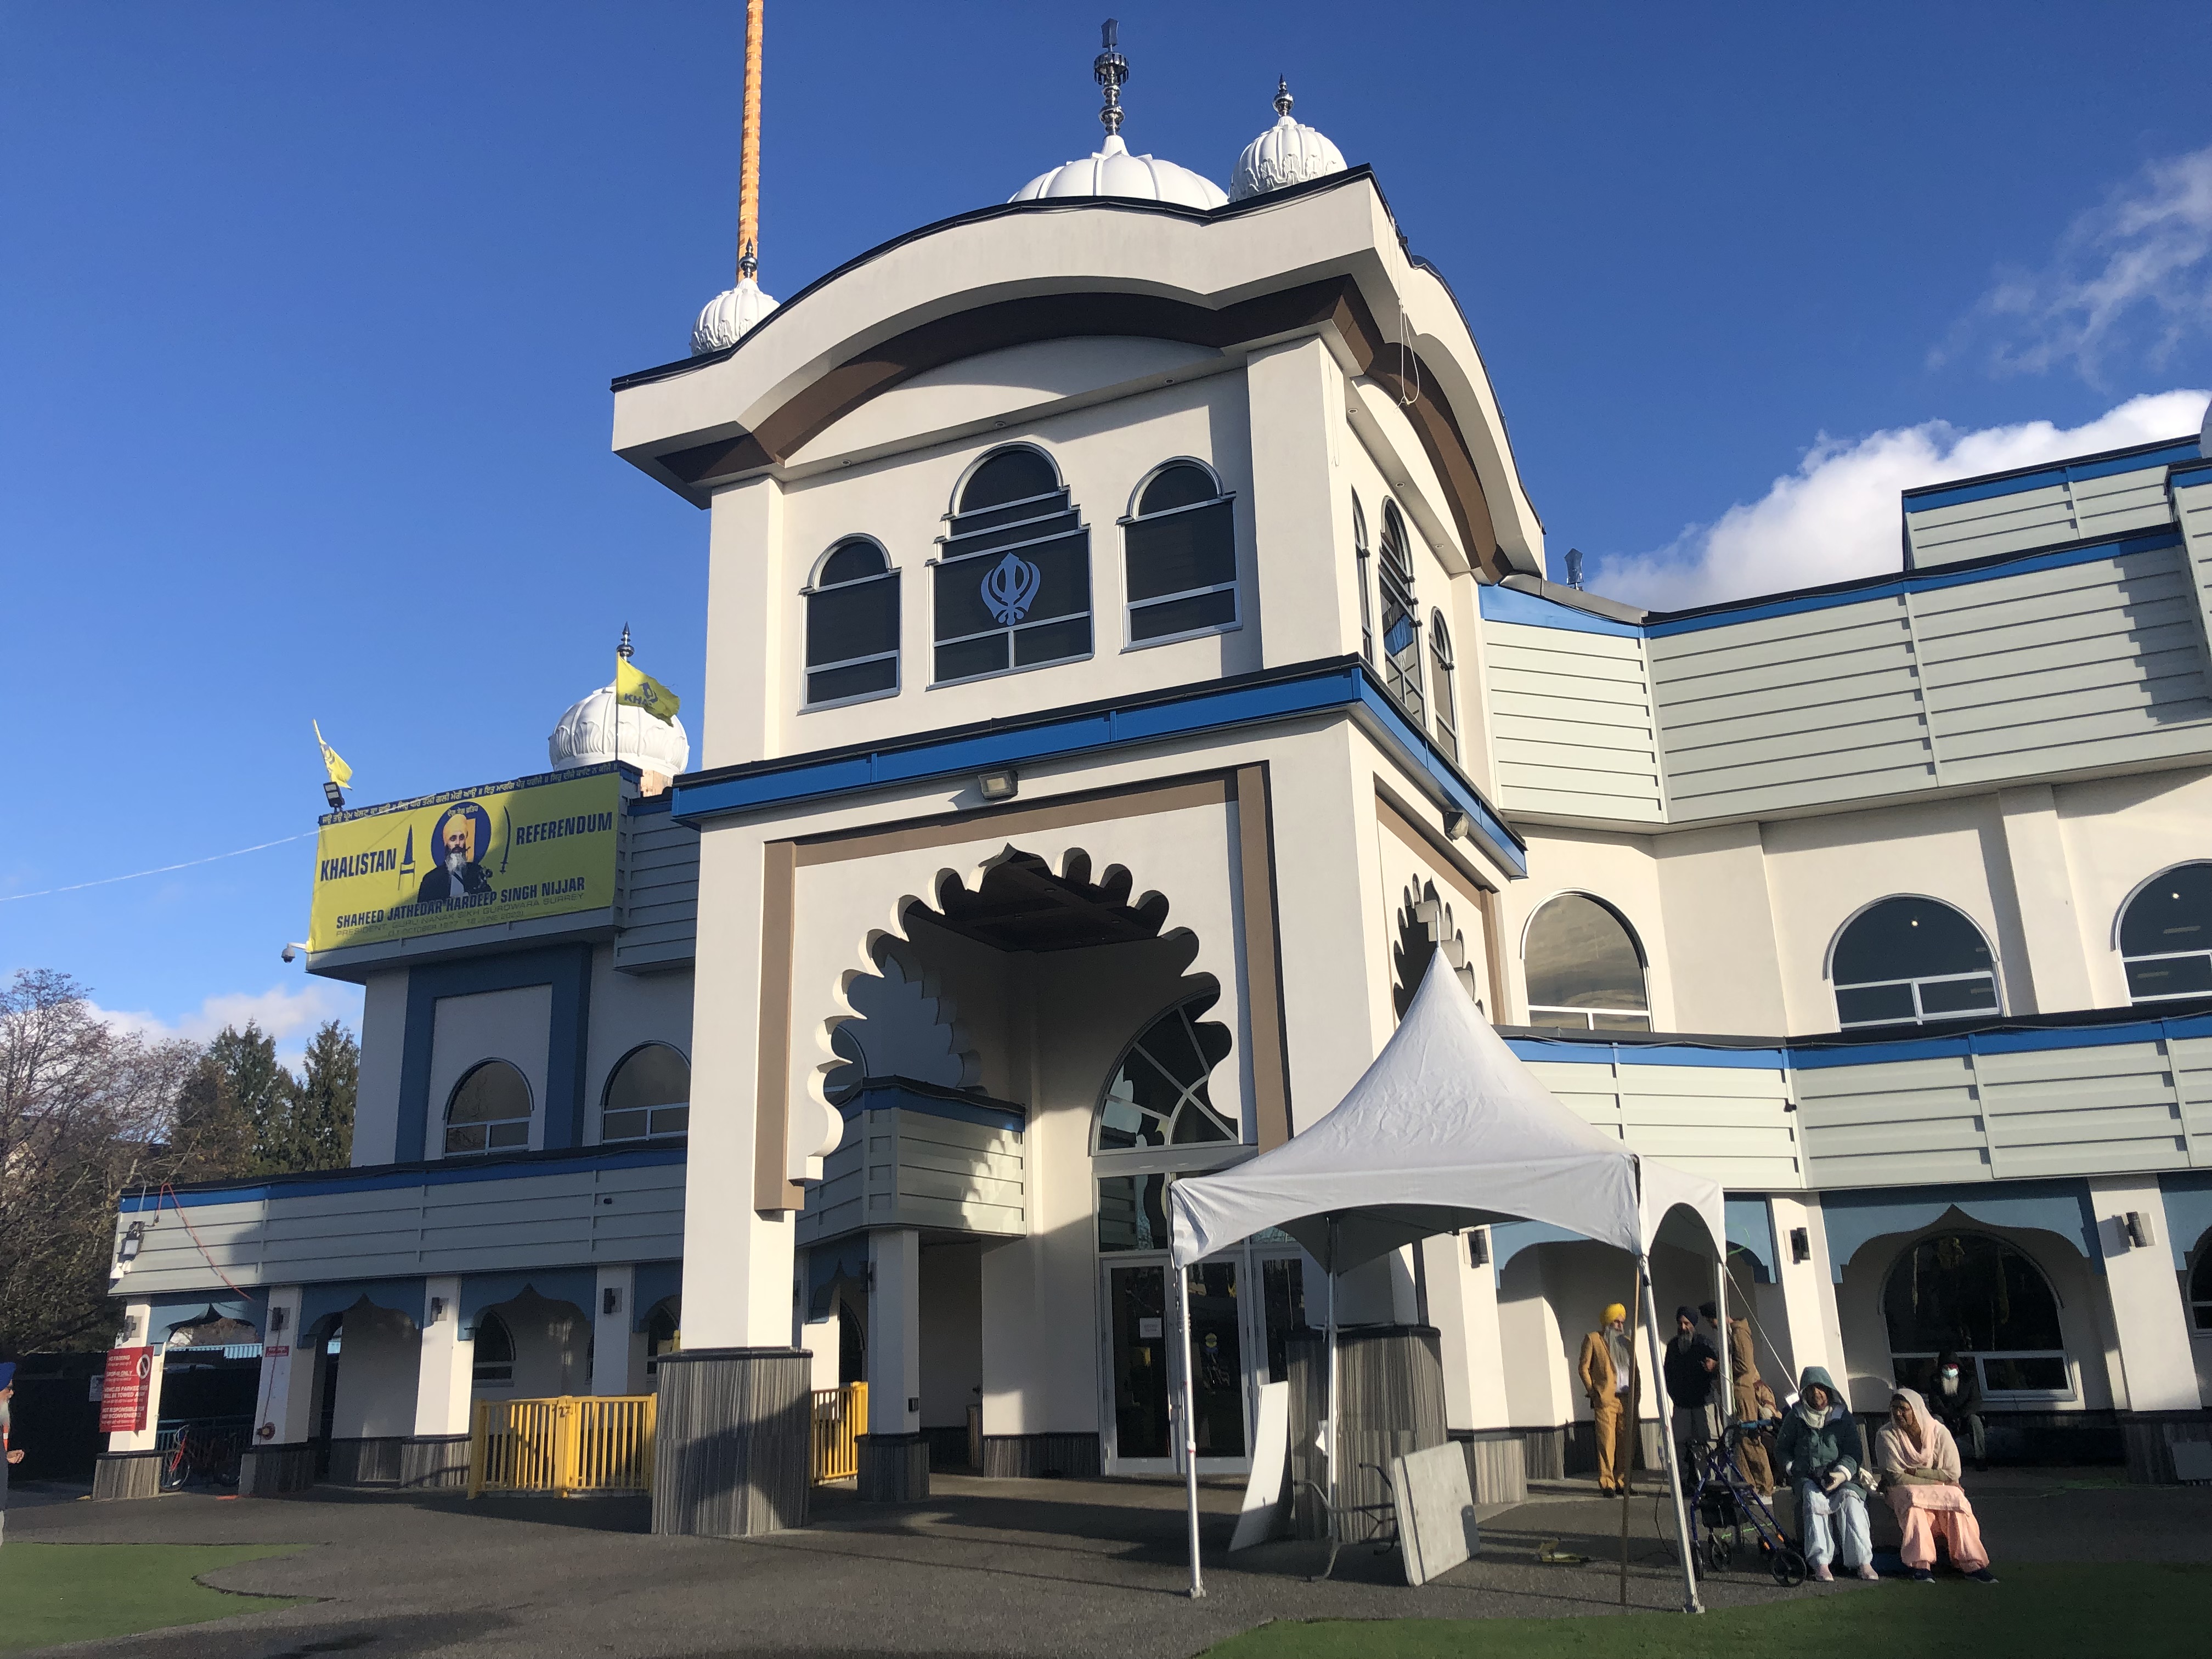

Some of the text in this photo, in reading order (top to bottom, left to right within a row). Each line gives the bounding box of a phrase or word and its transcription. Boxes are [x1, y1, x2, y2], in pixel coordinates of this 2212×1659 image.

[516, 811, 612, 845] REFERENDUM
[320, 848, 397, 882] KHALISTAN
[336, 877, 585, 929] SHAHEED JATHEDAR HARDEEP SINGH NIJJAR
[336, 923, 387, 936] PRESIDENT
[483, 900, 539, 914] GURDWARA
[542, 893, 584, 905] SURREY
